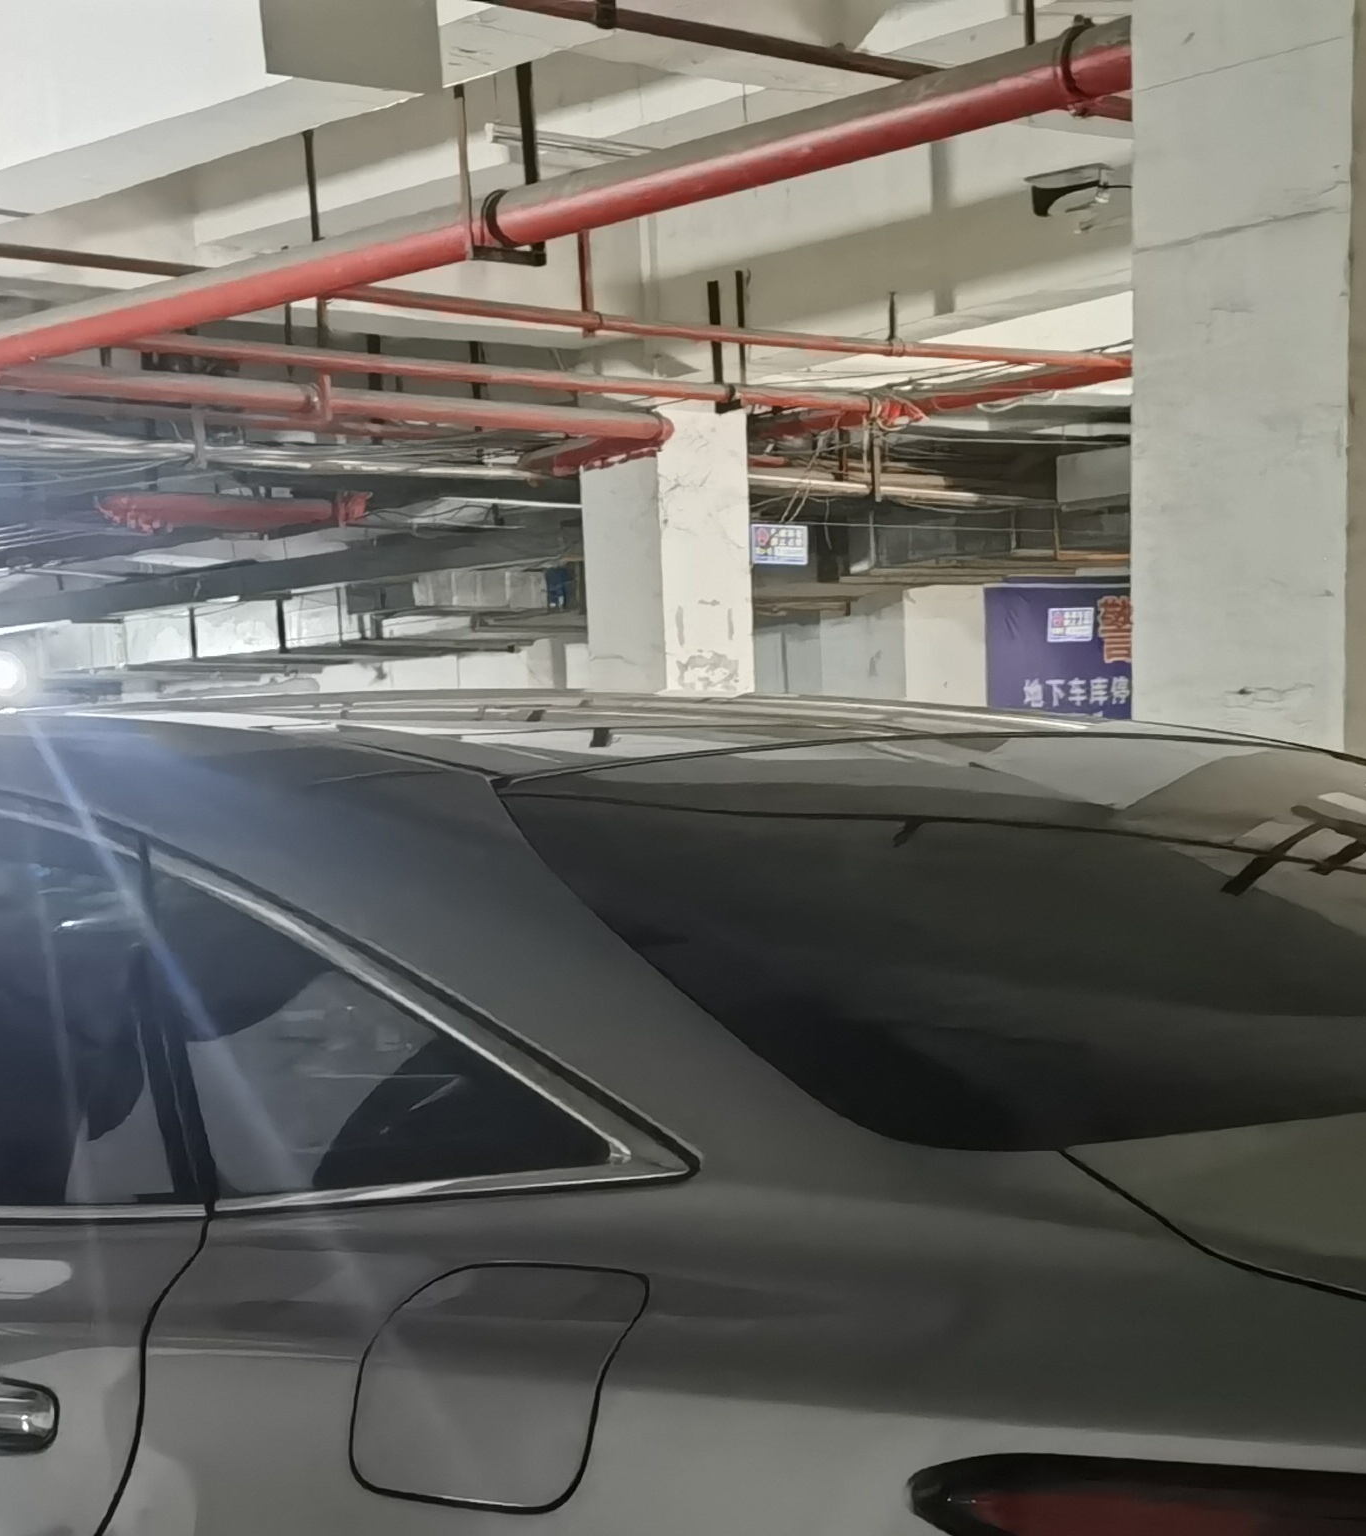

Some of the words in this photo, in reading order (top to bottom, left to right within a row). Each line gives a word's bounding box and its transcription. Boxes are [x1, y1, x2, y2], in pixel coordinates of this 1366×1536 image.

[1023, 676, 1130, 708] 地下车库停
